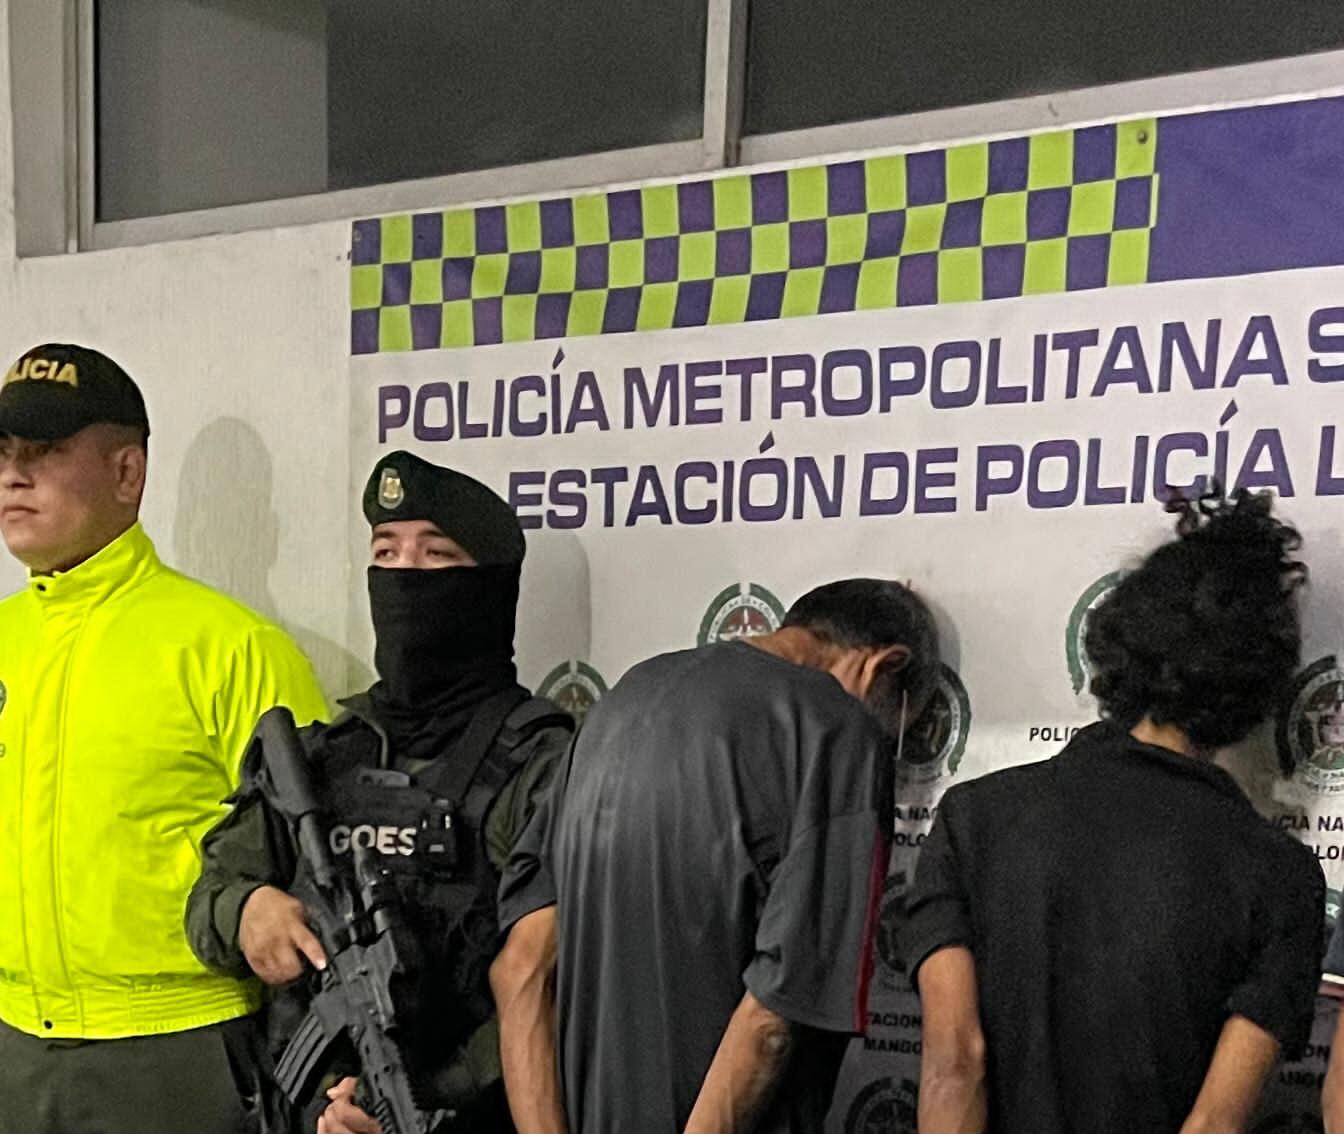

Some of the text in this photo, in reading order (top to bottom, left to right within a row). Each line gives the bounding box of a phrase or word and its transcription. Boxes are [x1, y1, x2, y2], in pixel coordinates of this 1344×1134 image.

[376, 347, 604, 444] POLICÍA
[623, 313, 1290, 431] METROPOLITANA
[508, 432, 846, 531] ESTACIÓN
[859, 446, 959, 518] DE
[976, 403, 1296, 512] POLICÍA
[329, 823, 418, 857] GOES
